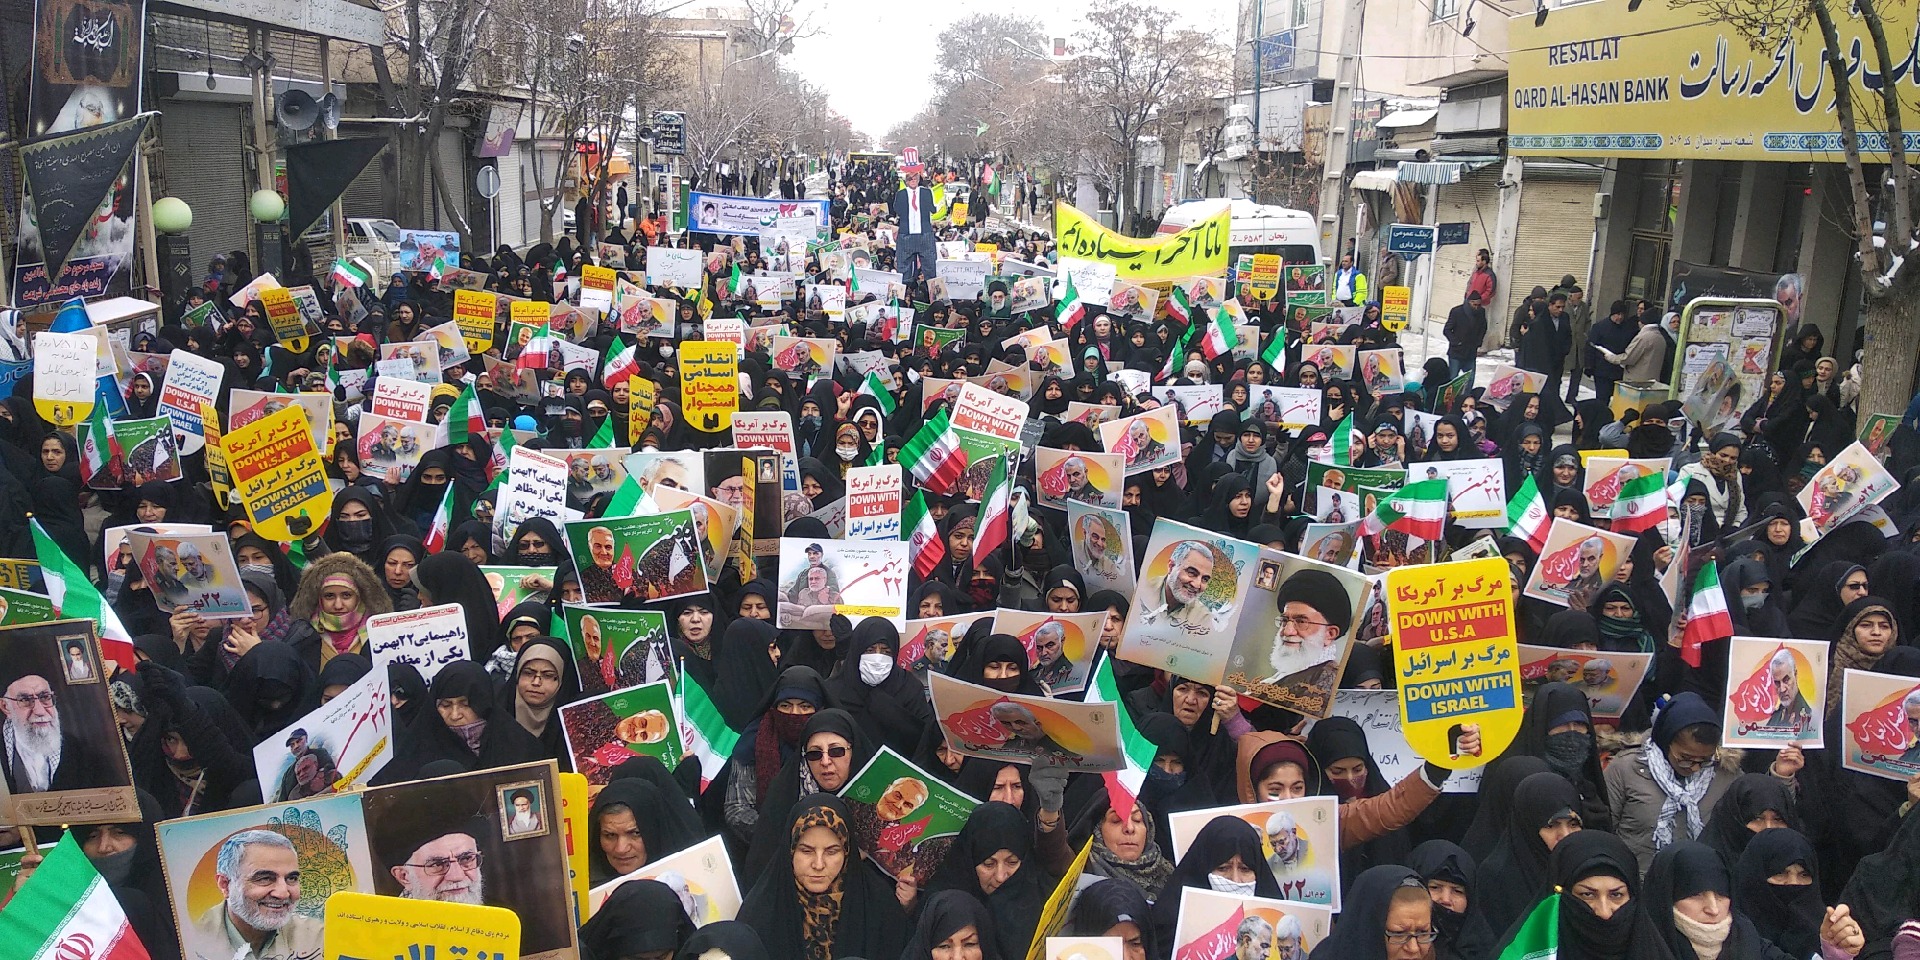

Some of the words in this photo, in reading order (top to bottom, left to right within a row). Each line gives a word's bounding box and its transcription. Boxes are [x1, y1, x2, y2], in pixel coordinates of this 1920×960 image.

[1548, 37, 1621, 66] RESALAT
[1680, 34, 1751, 99] رسالت
[1514, 86, 1547, 110] QARD
[1549, 80, 1620, 107] AL-HASAN
[1624, 76, 1669, 104] BANK
[1682, 134, 1692, 147] کد
[1695, 135, 1713, 150] میدان
[1715, 136, 1734, 151] سبزه
[1734, 132, 1754, 147] شعبه
[1393, 230, 1414, 238] عمومی
[1399, 241, 1427, 250] شهرداری
[457, 303, 475, 311] DOWN
[463, 331, 483, 339] ISRAEL
[683, 353, 733, 366] انقلاب
[683, 367, 734, 381] اسلامی
[165, 386, 189, 400] DOWN
[378, 384, 400, 395] آمریکا
[408, 390, 425, 400] مرگ
[684, 381, 735, 396] همچنان
[176, 398, 196, 411] U.S.A
[375, 397, 401, 409] DOWN
[401, 402, 423, 412] WITH
[686, 396, 736, 412] استوار
[964, 391, 992, 407] آمریکا
[160, 405, 182, 419] DOWN
[387, 409, 408, 419] U.S.A
[991, 404, 1001, 415] بر
[1002, 407, 1021, 421] مرگ
[171, 417, 194, 432] SRAEL
[278, 417, 302, 433] مرگ
[734, 419, 759, 430] آمریکا
[761, 420, 769, 431] بر
[769, 420, 788, 431] مرگ
[959, 406, 990, 423] DOWN
[990, 418, 1017, 435] WITH
[266, 427, 277, 441] بر
[737, 434, 764, 442] DOWN
[764, 434, 789, 442] WITH
[227, 431, 263, 454] آمریکا
[234, 443, 278, 470] DOWN
[277, 430, 307, 455] WITH
[257, 452, 290, 471] U.S.A
[293, 456, 317, 474] مرگ
[283, 465, 293, 480] بر
[245, 470, 282, 498] اسرائیل
[512, 482, 538, 495] مظاهر
[536, 473, 566, 490] راهپیمایی
[851, 475, 874, 490] آمریکا
[875, 479, 882, 489] بر
[882, 475, 900, 489] مرگ
[251, 487, 291, 513] DOWN
[290, 473, 322, 498] WITH
[538, 488, 546, 499] از
[545, 491, 563, 505] یکی
[851, 493, 876, 505] DOWN
[877, 491, 899, 502] WITH
[1485, 487, 1500, 502] ۲۲
[270, 491, 310, 515] ISRAEL
[515, 500, 535, 514] مردم
[863, 505, 885, 515] U.S.A
[534, 506, 558, 517] حضور
[849, 522, 876, 537] اسرائیل
[876, 521, 883, 532] بر
[883, 518, 899, 530] مرگ
[883, 577, 902, 597] ۲۲
[1396, 578, 1446, 605] آمریکا
[1451, 582, 1464, 602] بر
[1466, 575, 1503, 596] مرگ
[1400, 611, 1456, 630] DOWN
[1456, 603, 1504, 622] WITH
[398, 633, 414, 647] ۲۲
[414, 626, 466, 647] راهپیمایی
[1430, 624, 1476, 642] U.S.A
[373, 640, 399, 654] بهمن
[437, 645, 465, 664] یکی
[1478, 644, 1510, 665] مرگ
[389, 654, 421, 665] مظاه
[424, 650, 435, 667] از
[1402, 650, 1457, 678] اسرائیل
[1461, 650, 1475, 671] بر
[1407, 682, 1463, 701] DOWN
[1466, 674, 1512, 694] WITH
[1431, 694, 1489, 715] ISRAEL
[1379, 754, 1400, 765] USA
[364, 916, 383, 924] رهبری
[470, 928, 484, 936] دفاع
[495, 931, 510, 940] مردم
